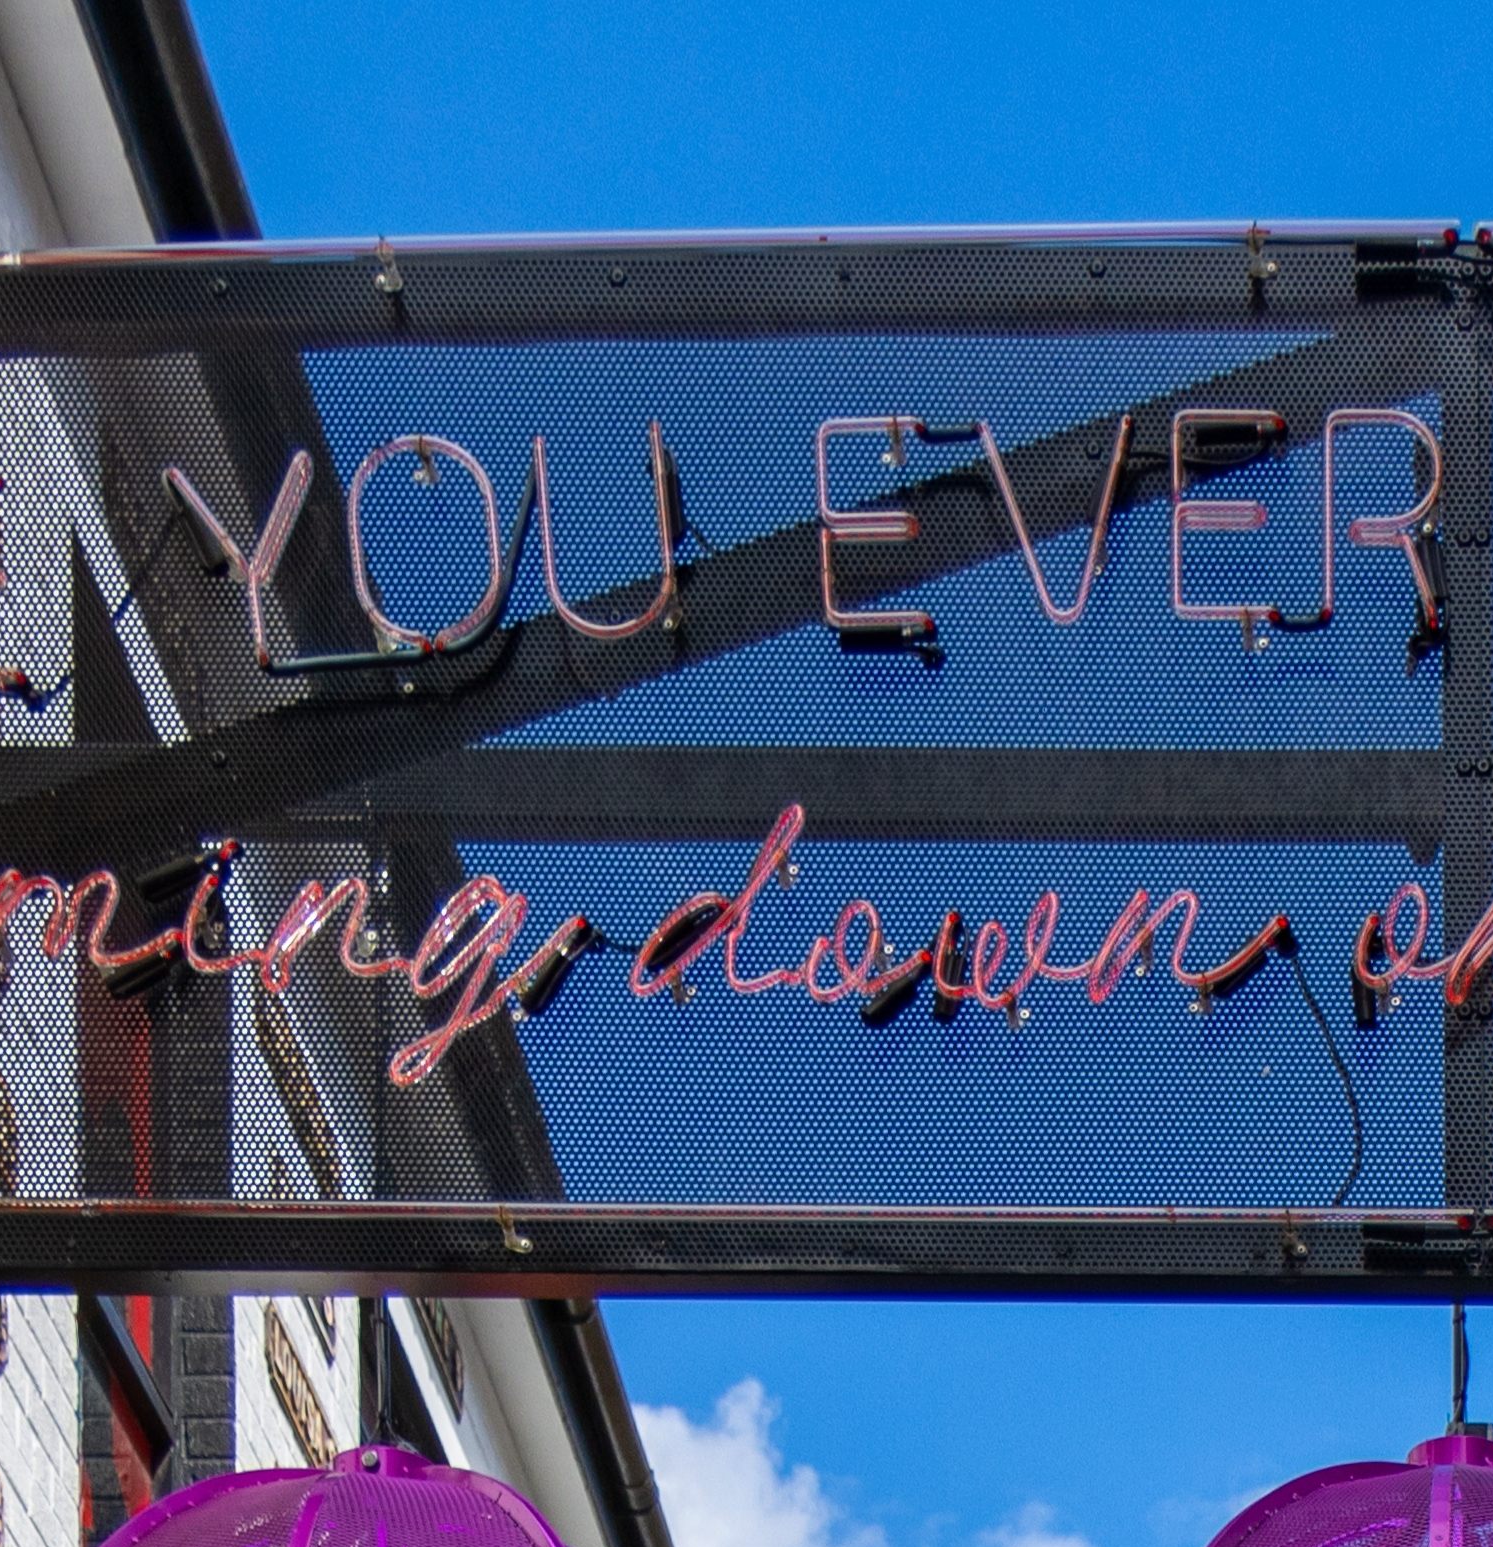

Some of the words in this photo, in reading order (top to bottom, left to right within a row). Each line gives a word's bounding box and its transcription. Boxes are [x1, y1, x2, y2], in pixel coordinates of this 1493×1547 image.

[166, 421, 678, 668] YOU
[815, 408, 1444, 633] EVER
[629, 803, 1288, 1005] down
